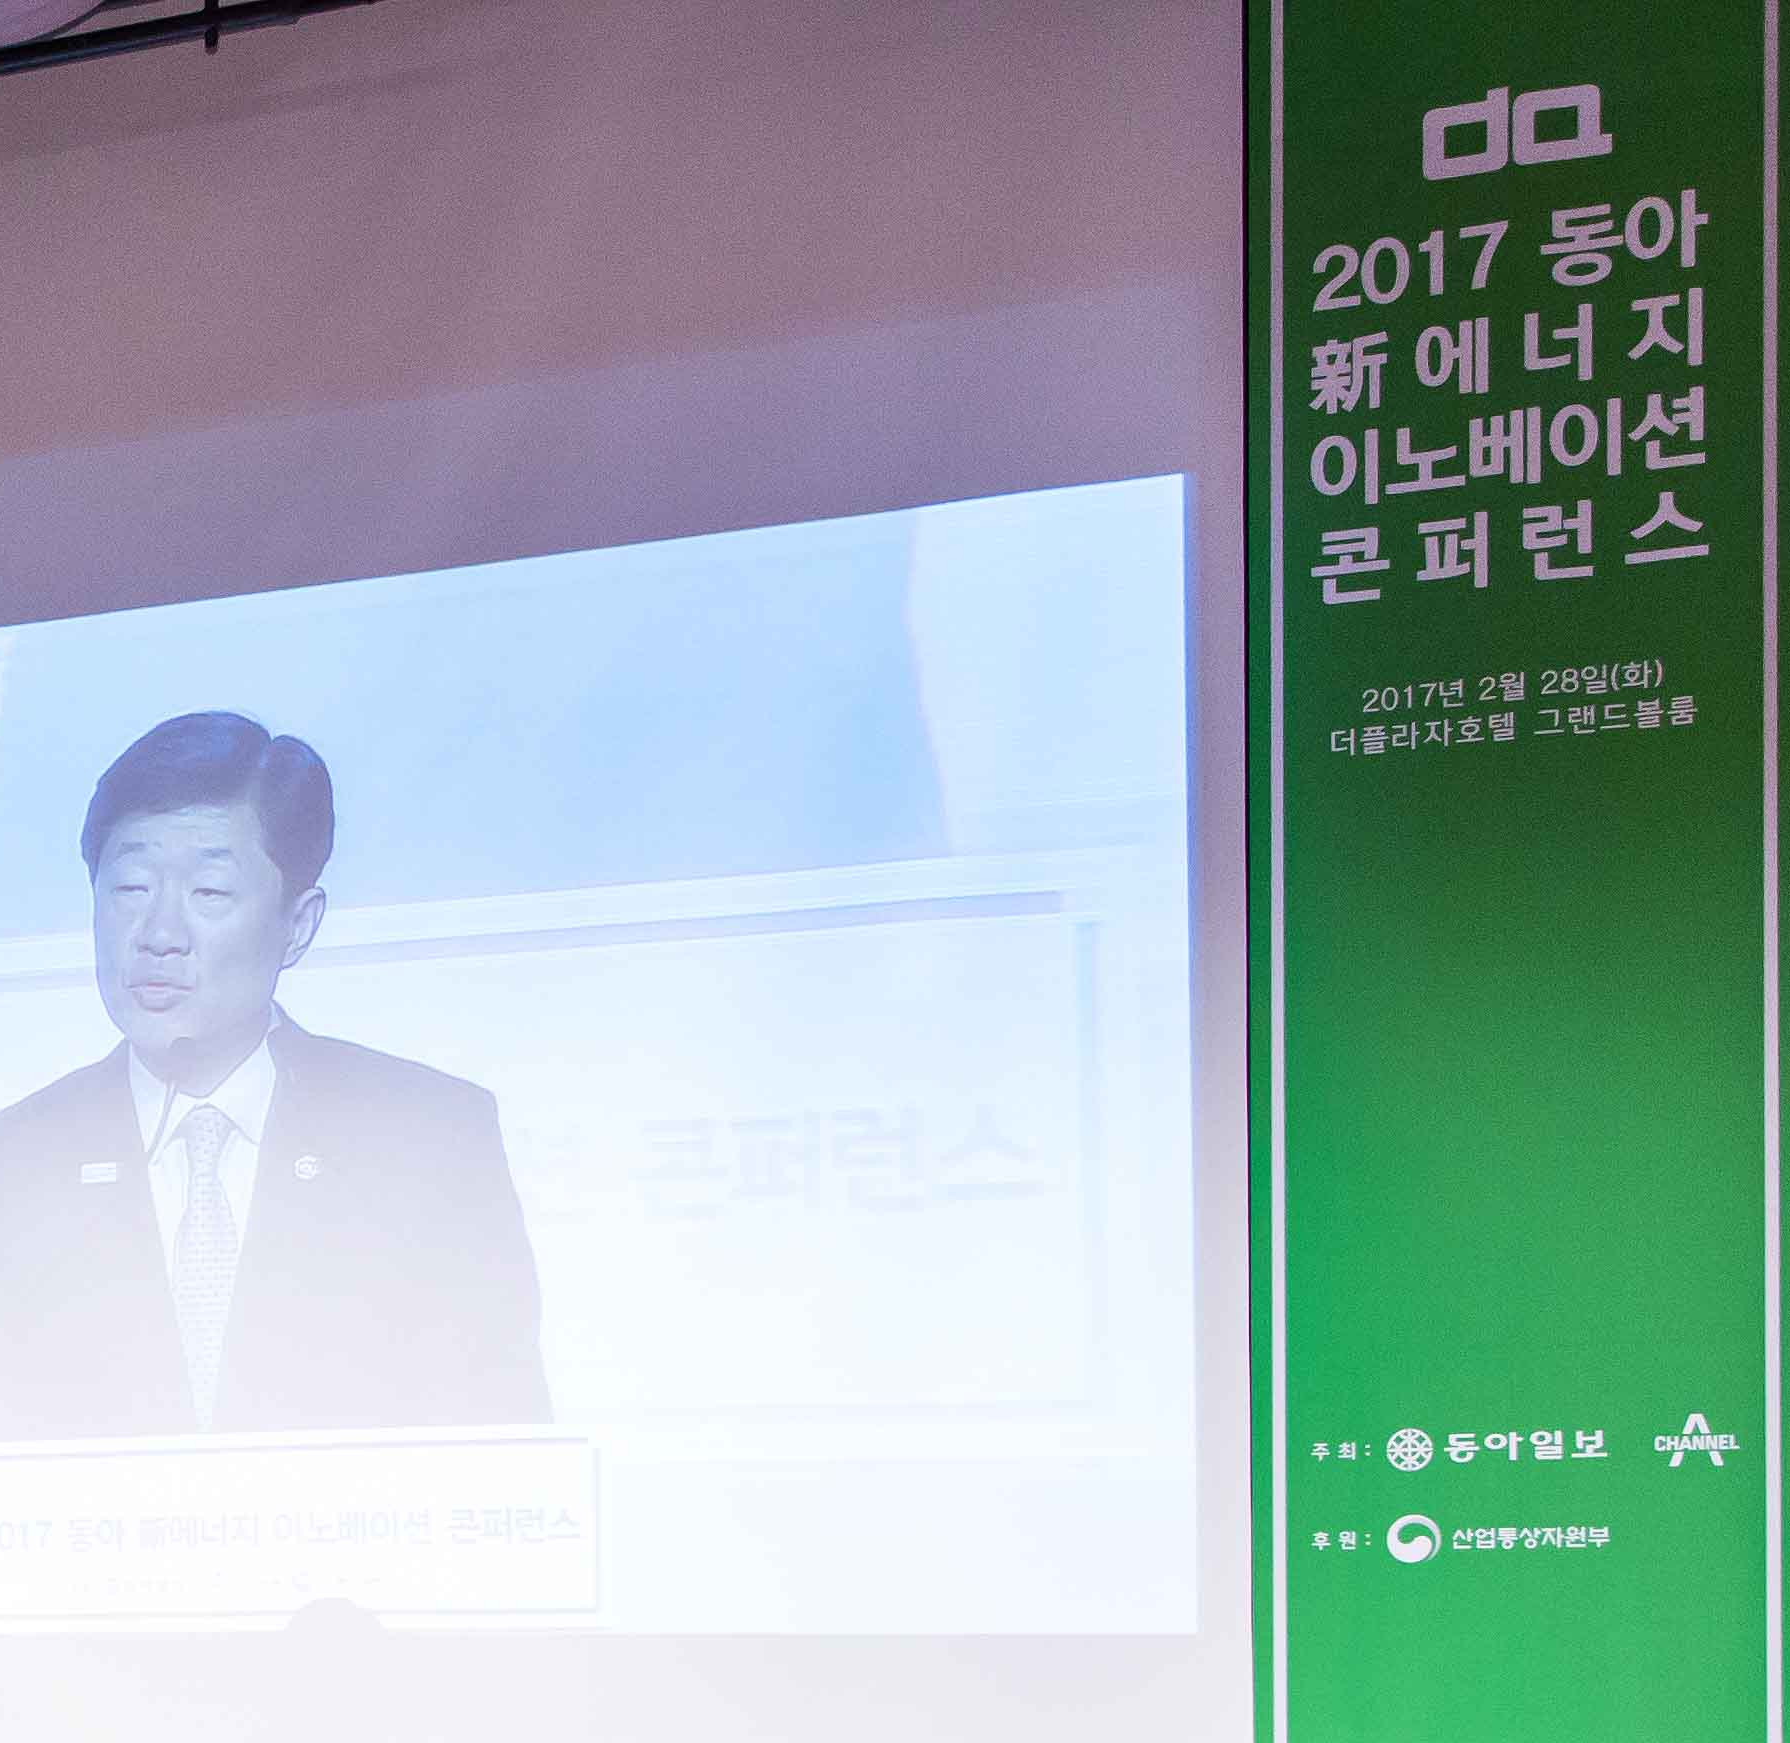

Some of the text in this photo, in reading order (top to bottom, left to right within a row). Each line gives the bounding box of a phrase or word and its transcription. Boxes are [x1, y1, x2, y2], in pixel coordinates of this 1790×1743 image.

[1312, 189, 1708, 312] 2017 동아
[1310, 386, 1706, 504] 이노베이션
[1310, 491, 1709, 604] 콘퍼런스
[1362, 659, 1663, 713] 2017년 2월 28일(화)
[1330, 696, 1698, 756] 더플라자호텔 그랜드볼룸
[1443, 1429, 1608, 1463] 동아일보
[1654, 1433, 1740, 1452] CHANNEL
[1453, 1526, 1610, 1550] 산업통상자원부
